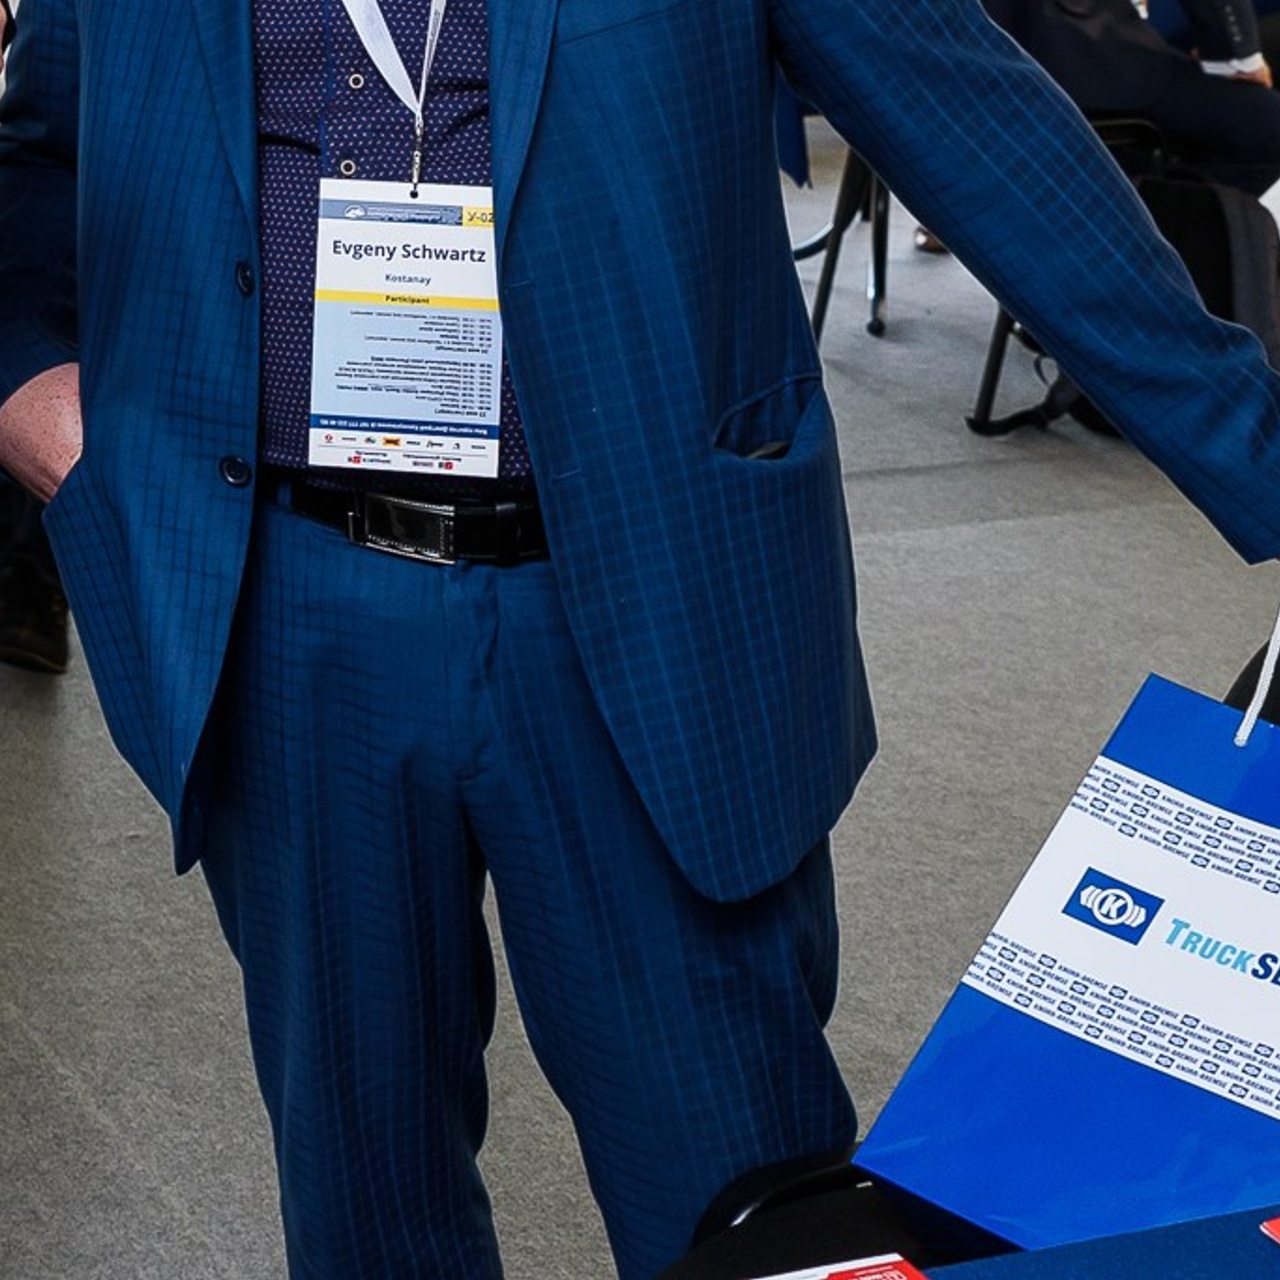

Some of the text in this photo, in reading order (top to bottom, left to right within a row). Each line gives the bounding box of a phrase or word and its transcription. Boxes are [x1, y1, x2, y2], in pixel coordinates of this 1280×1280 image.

[332, 240, 486, 263] Evgeny Schwartz
[385, 273, 432, 285] Kostanay
[385, 294, 430, 305] Participant
